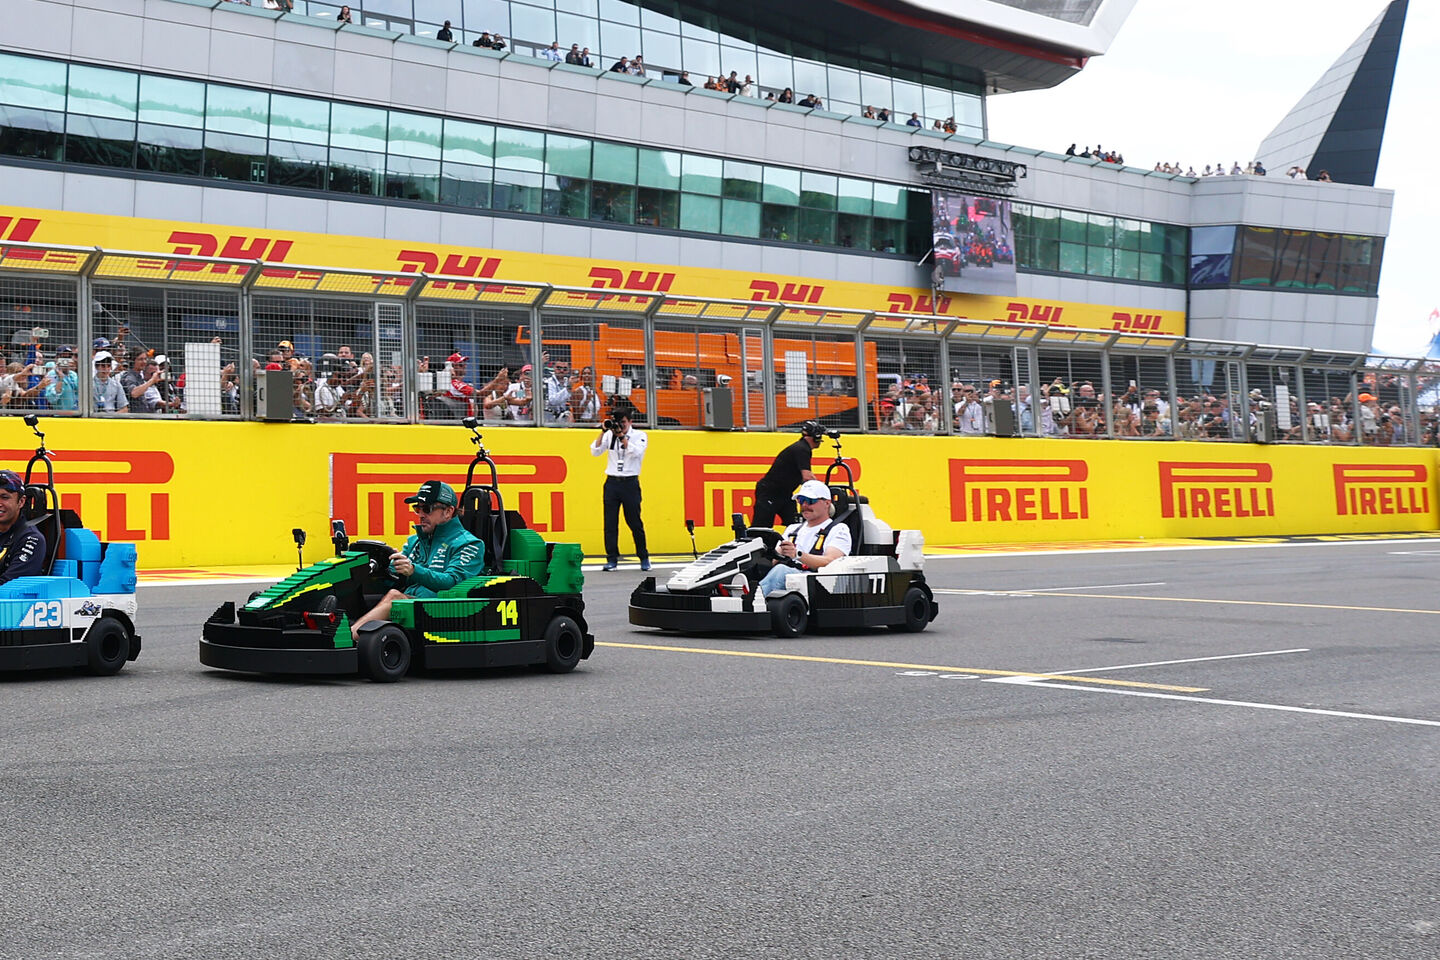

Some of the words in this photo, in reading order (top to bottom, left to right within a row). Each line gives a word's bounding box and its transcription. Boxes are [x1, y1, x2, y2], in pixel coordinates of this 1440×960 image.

[164, 231, 298, 279] DHL
[393, 249, 504, 294] DHL
[587, 266, 677, 305] DHL
[748, 279, 825, 316] DHL
[885, 292, 953, 324] DHL
[1005, 302, 1064, 334] DHL
[1111, 311, 1162, 335] DHL
[948, 458, 1089, 522] PIRELLI
[1158, 461, 1275, 518] PIRELLI
[1333, 464, 1430, 516] PIRELLI
[869, 573, 886, 595] 77
[34, 600, 62, 628] 23
[496, 599, 518, 626] 14
